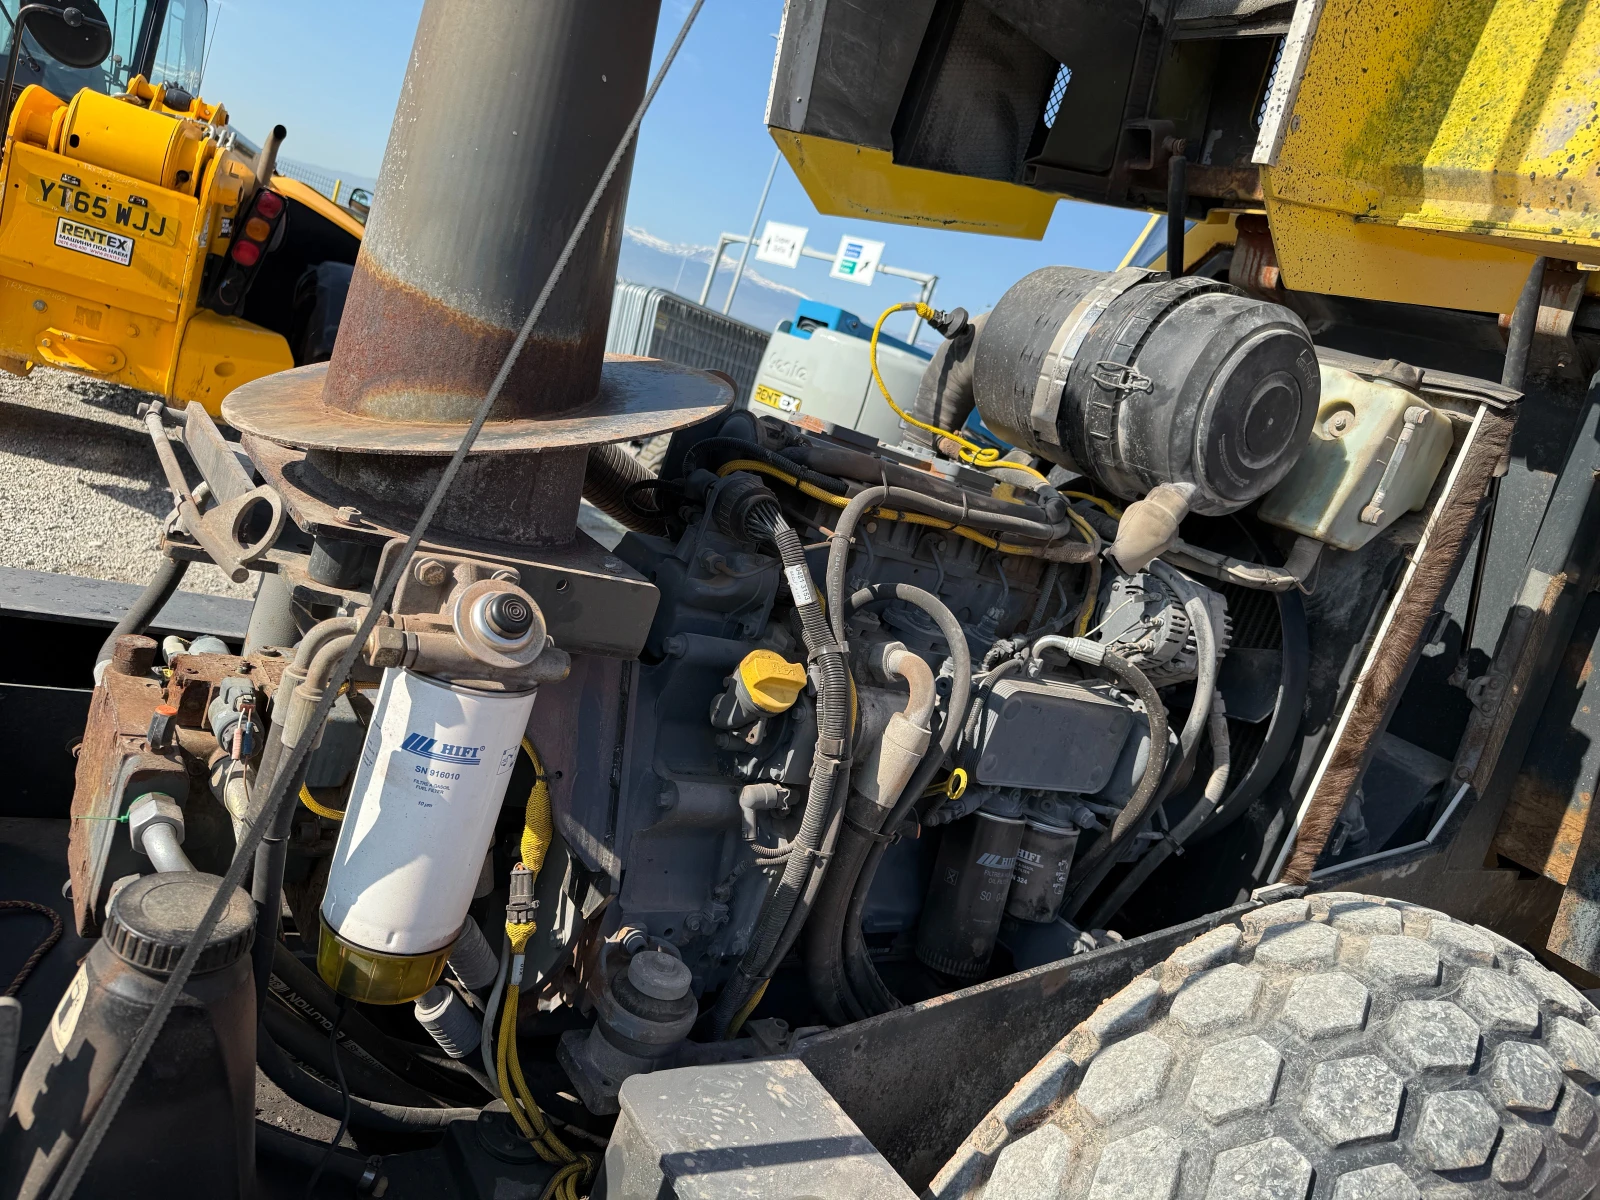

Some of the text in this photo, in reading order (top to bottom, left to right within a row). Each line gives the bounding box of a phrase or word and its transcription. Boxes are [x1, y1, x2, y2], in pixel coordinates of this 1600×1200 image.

[39, 178, 107, 219] YT65
[115, 203, 167, 237] WJJ
[58, 233, 128, 258] МАШИНИ ПОД НАЕМ
[61, 222, 129, 251] RENTEX
[755, 387, 800, 412] RENTEX
[440, 744, 480, 758] HIFI
[415, 765, 461, 780] SN 916010
[415, 784, 428, 792] FUEL
[1017, 877, 1028, 885] 324
